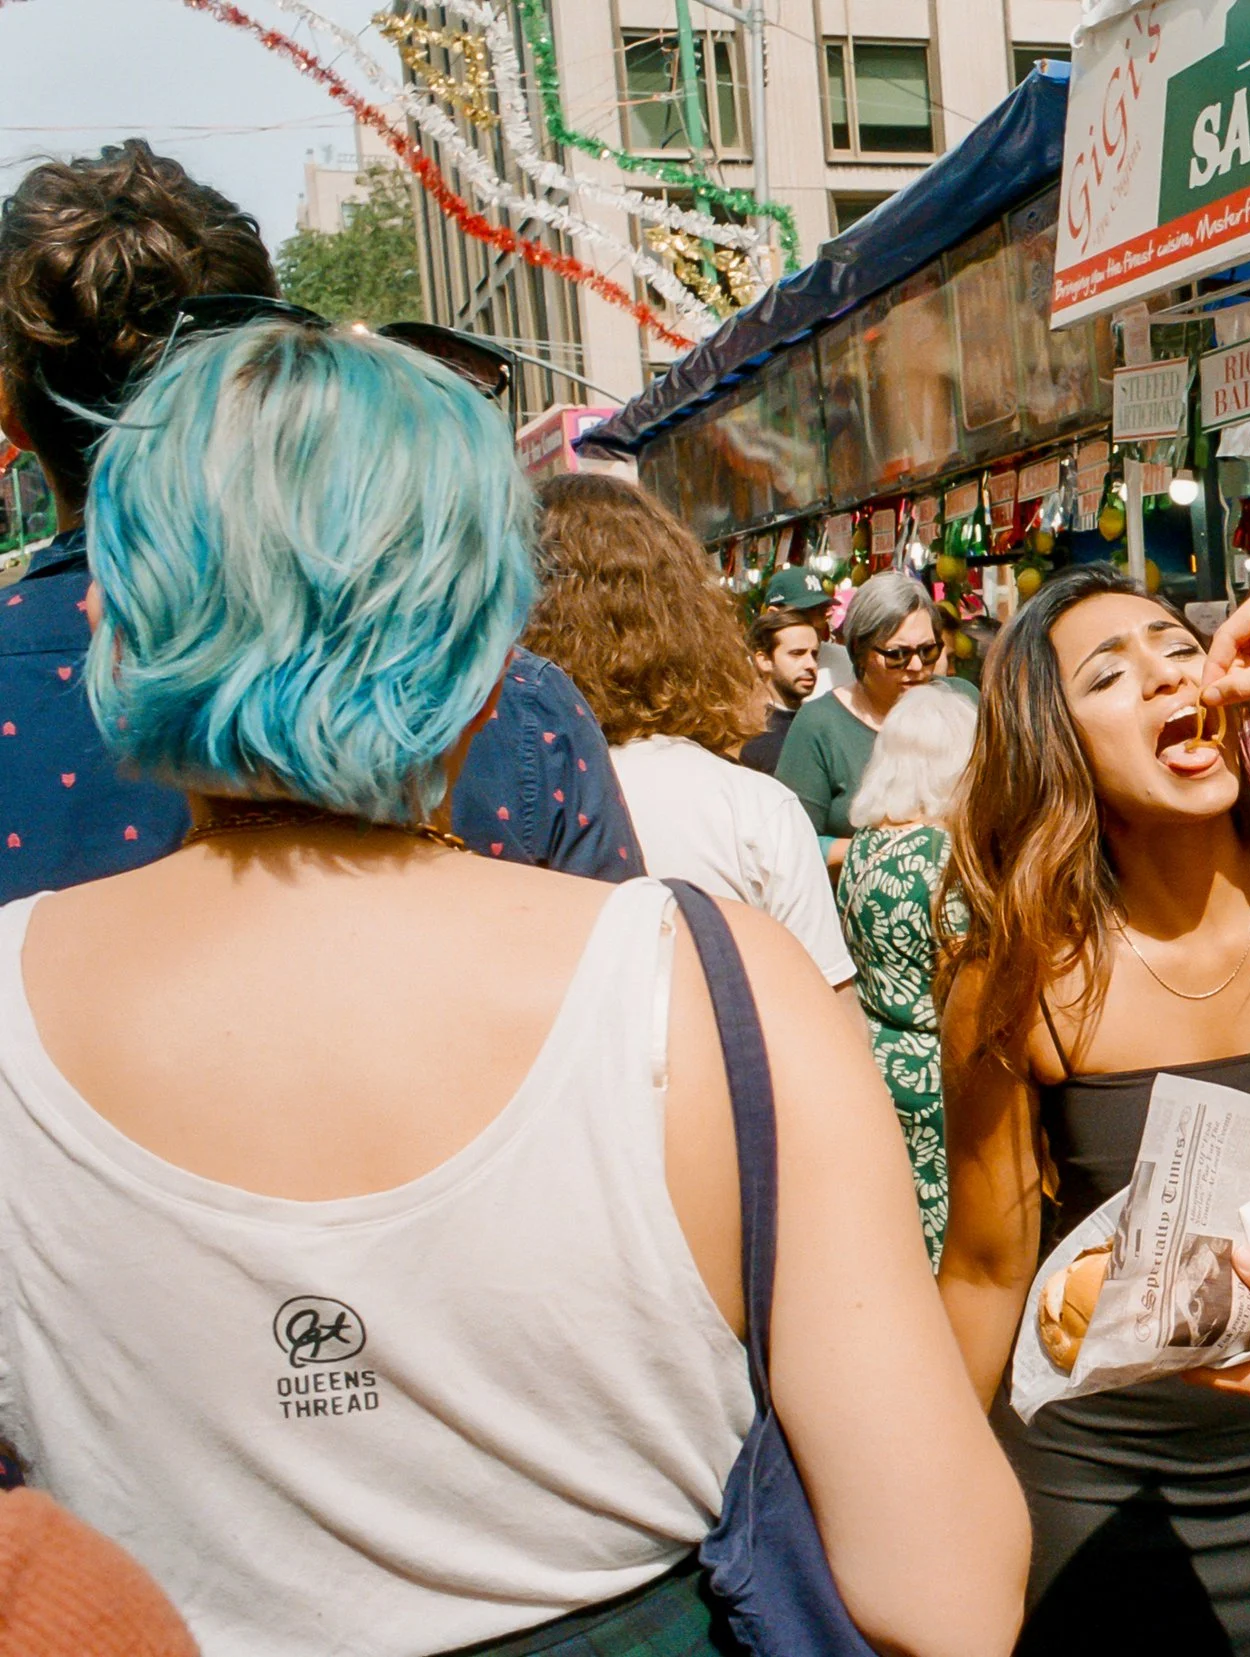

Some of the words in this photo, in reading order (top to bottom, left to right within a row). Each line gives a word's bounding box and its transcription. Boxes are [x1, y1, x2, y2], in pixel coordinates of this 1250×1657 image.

[1055, 274, 1091, 300] Bringing
[1106, 257, 1124, 276] the
[1123, 239, 1153, 273] finest
[1157, 231, 1194, 258] cuisine,
[1162, 1138, 1186, 1204] Times
[277, 1370, 377, 1397] QUEENS
[279, 1391, 379, 1419] THREAD
